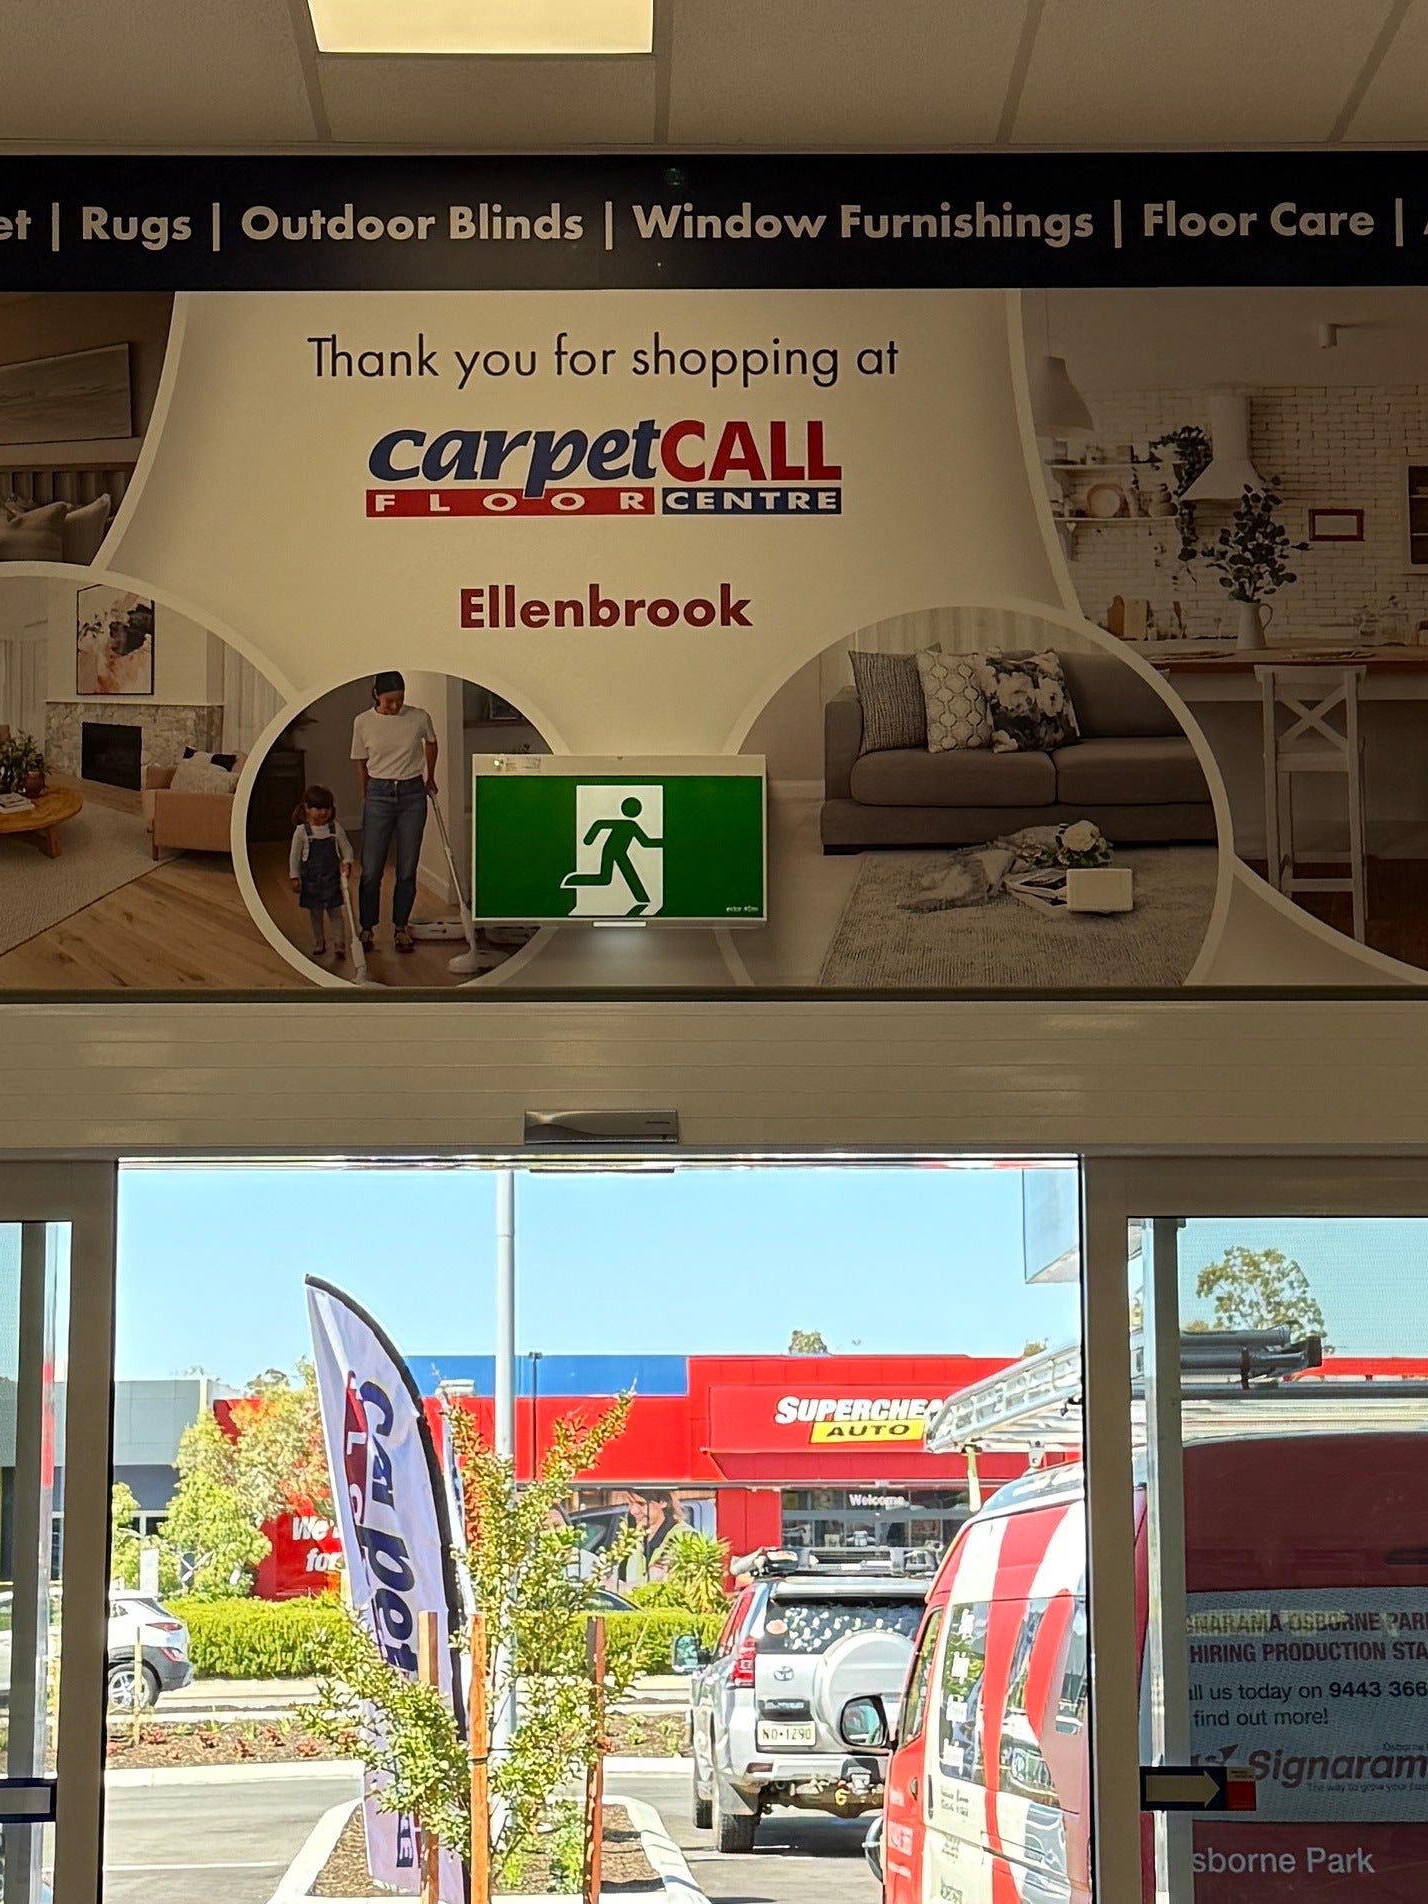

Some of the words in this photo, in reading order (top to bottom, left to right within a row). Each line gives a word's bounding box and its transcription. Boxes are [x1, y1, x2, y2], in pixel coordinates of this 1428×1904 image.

[82, 205, 192, 251] Rugs
[241, 202, 436, 240] Outdoor
[449, 203, 583, 240] Blinds
[633, 201, 827, 239] Window
[841, 201, 1094, 248] Furnishings
[1143, 199, 1257, 237] Floor
[1270, 201, 1374, 237] Care
[307, 333, 440, 378] Thank
[454, 348, 536, 390] you
[554, 332, 616, 377] for
[631, 331, 839, 388] shopping
[857, 340, 899, 376] at
[368, 418, 843, 499] carpetCALL
[375, 491, 646, 513] FLOOR
[665, 489, 838, 511] CENTRE
[460, 582, 753, 629] Ellenbrook
[774, 1395, 949, 1425] SUPERCHEA
[826, 1423, 911, 1438] AUTO
[1289, 1611, 1381, 1632] OSBORNE
[1189, 1644, 1257, 1664] HIRING
[1262, 1641, 1387, 1662] PRODUCTION
[1210, 1686, 1233, 1701] us
[1239, 1683, 1293, 1704] today
[1298, 1685, 1323, 1699] on
[1328, 1682, 1382, 1698] 9443
[1194, 1709, 1230, 1727] find
[1236, 1709, 1267, 1726] out
[1274, 1708, 1329, 1725] more!
[1192, 1847, 1297, 1874] sborne
[1306, 1847, 1376, 1874] Park
